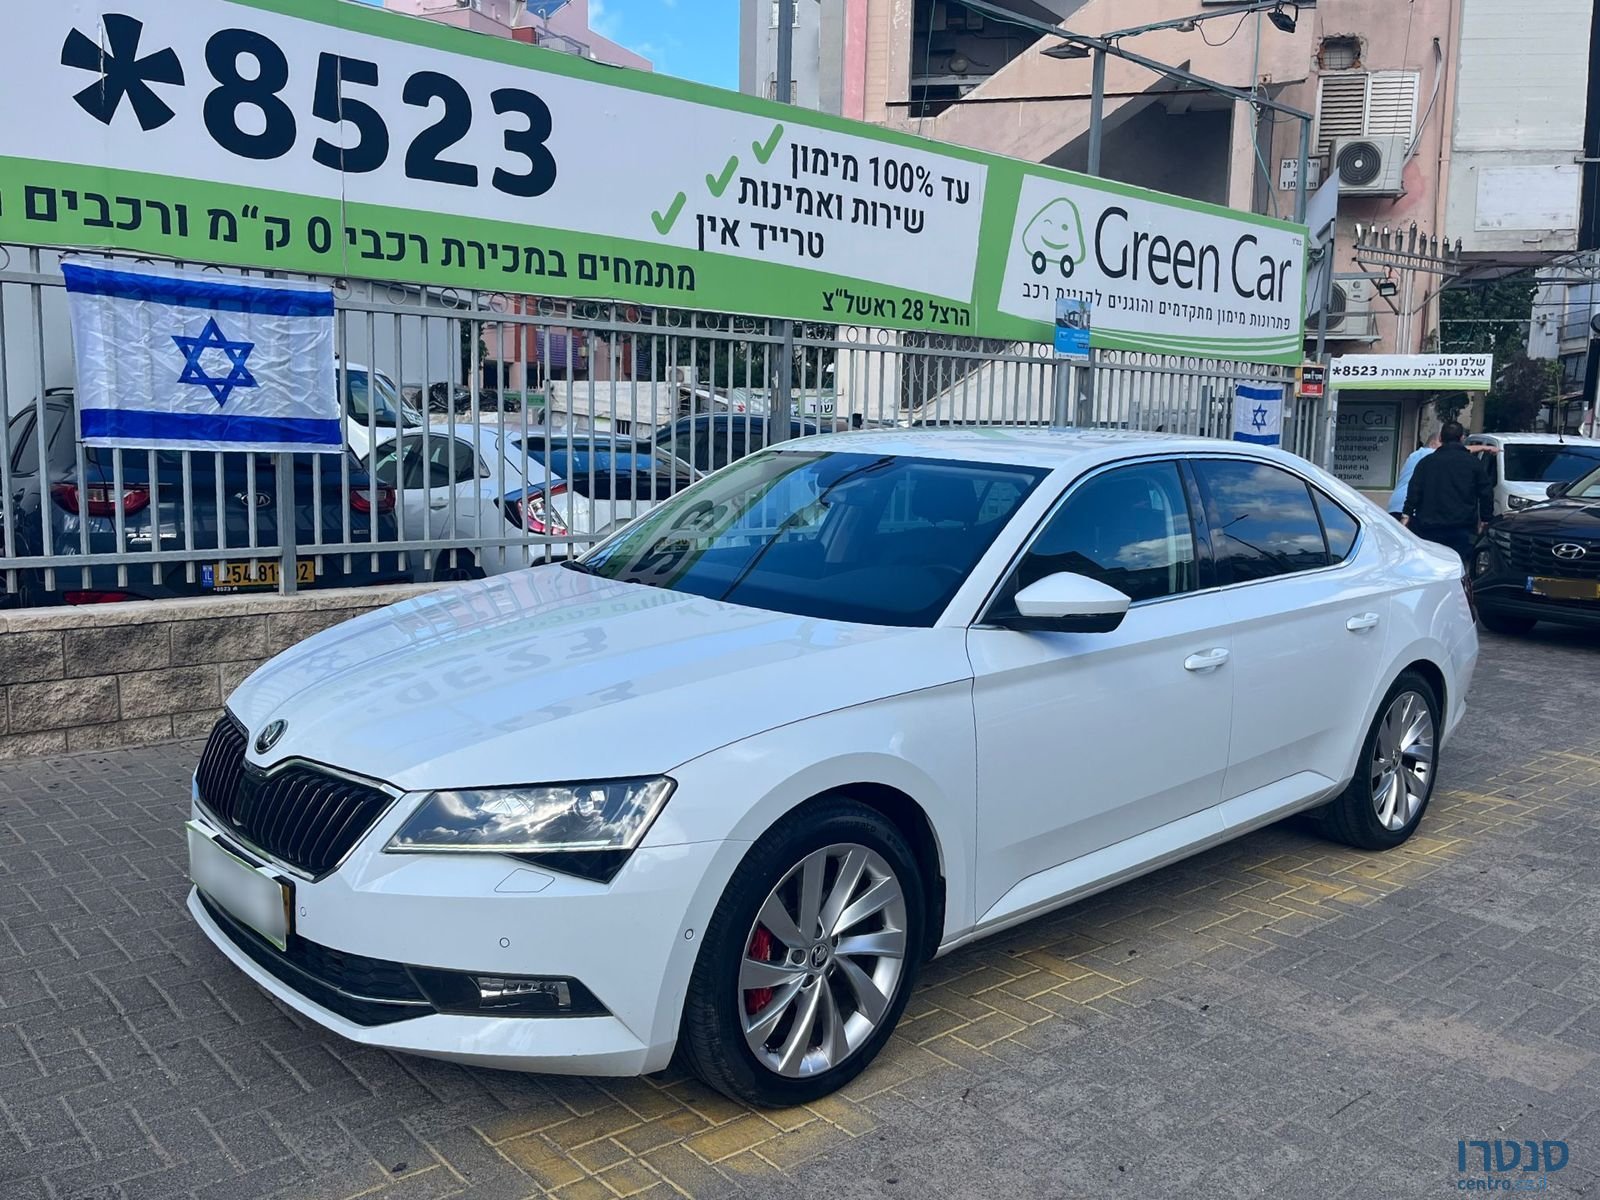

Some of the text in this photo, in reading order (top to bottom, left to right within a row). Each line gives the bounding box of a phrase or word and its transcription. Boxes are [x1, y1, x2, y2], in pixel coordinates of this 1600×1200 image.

[791, 143, 969, 204] עד 100% מימון
[25, 185, 188, 237] ורכבים
[738, 177, 924, 234] שירות ואמינות
[307, 216, 332, 254] 0
[345, 227, 428, 264] רכבי
[697, 214, 824, 258] טרייד אין
[441, 238, 567, 278] במכירת
[1095, 206, 1292, 302] Green Car
[578, 253, 695, 291] מתמחים
[1022, 282, 1049, 300] רכב
[902, 298, 924, 321] 28
[929, 300, 970, 327] הרצל
[1109, 294, 1153, 313] והוגנים
[1159, 301, 1213, 322] מתקדמים
[1218, 309, 1246, 325] מימון
[1249, 313, 1290, 330] פתרונות
[1381, 368, 1410, 376] אחרת
[1413, 368, 1436, 378] קצת
[1440, 368, 1452, 376] זה
[1455, 367, 1485, 376] אצלנו
[1462, 357, 1486, 367] שלם
[1362, 409, 1392, 425] Car
